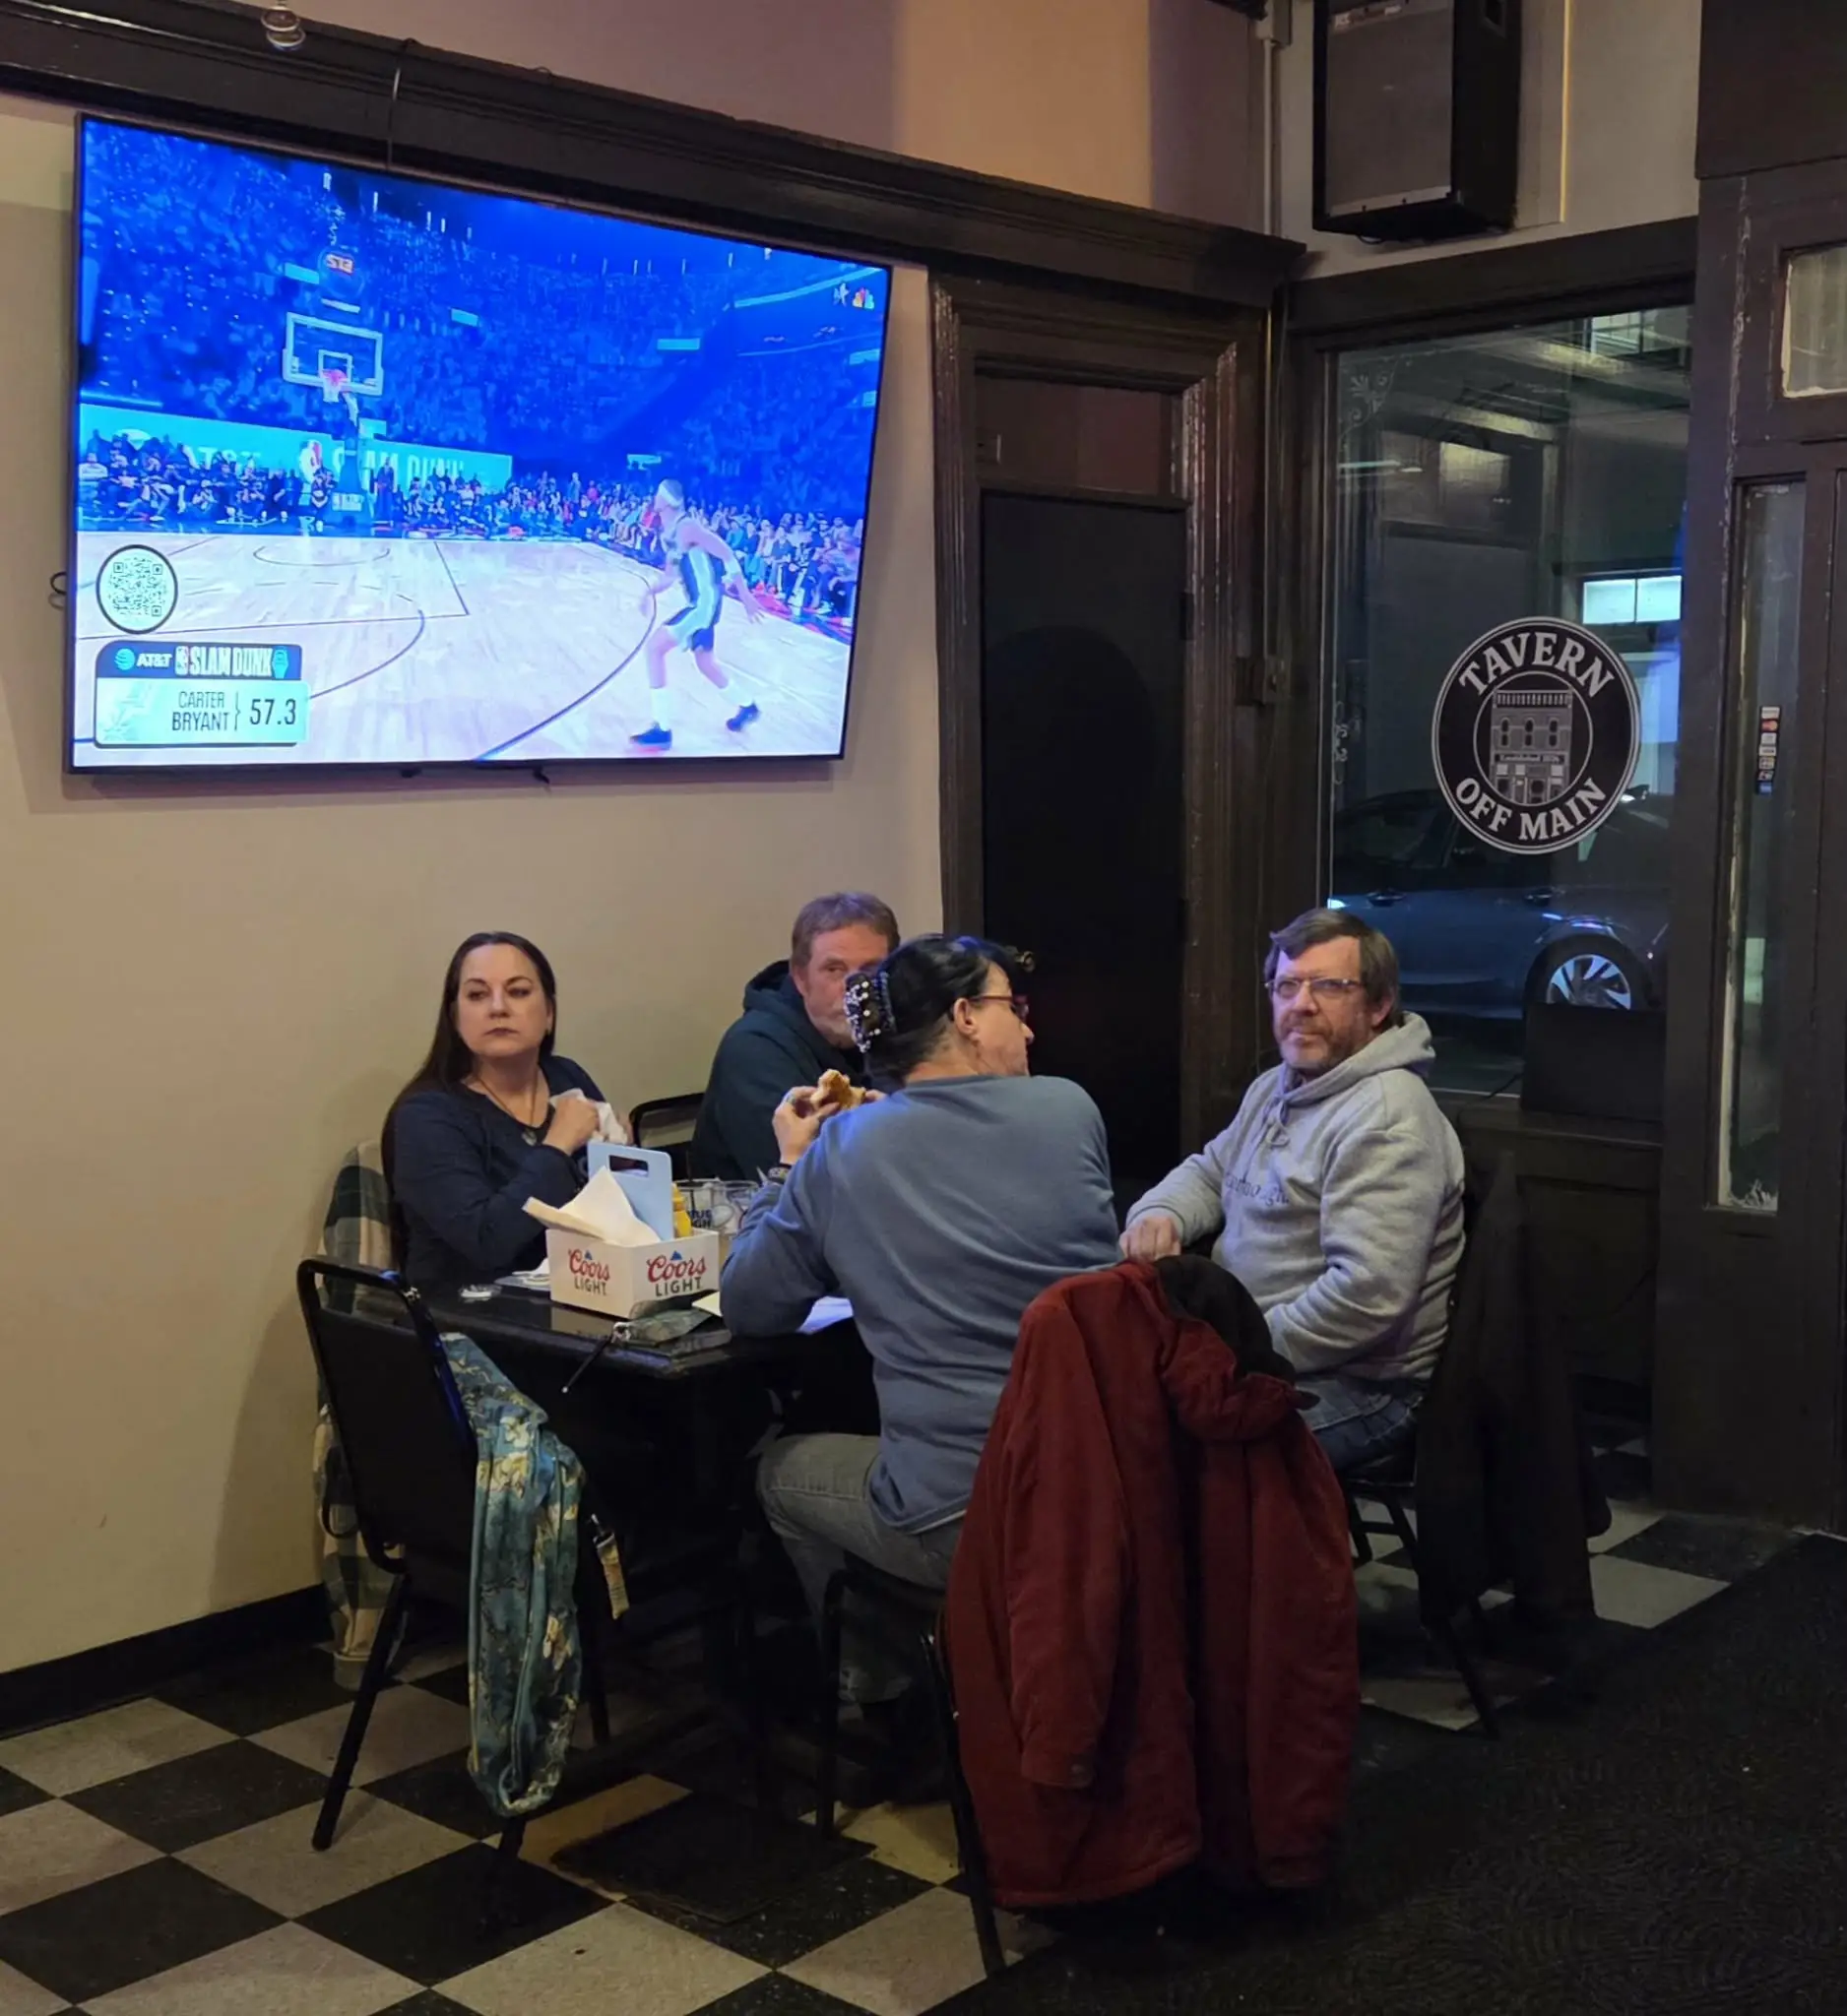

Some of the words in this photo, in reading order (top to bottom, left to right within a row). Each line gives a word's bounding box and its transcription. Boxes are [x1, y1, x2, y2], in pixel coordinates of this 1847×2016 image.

[136, 653, 172, 668] AT&T
[189, 646, 231, 677] SLAM
[232, 647, 274, 678] DUNK
[1458, 631, 1615, 698] TAVERN
[178, 691, 225, 709] CARTER
[249, 698, 296, 725] 57.3
[171, 711, 229, 731] BRYANT
[1456, 778, 1512, 832] OFF
[1519, 778, 1607, 840] MAIN
[568, 1248, 610, 1282] Coors
[647, 1254, 706, 1284] Coors
[574, 1277, 606, 1296] LIGHT
[656, 1276, 702, 1297] LIGHT
